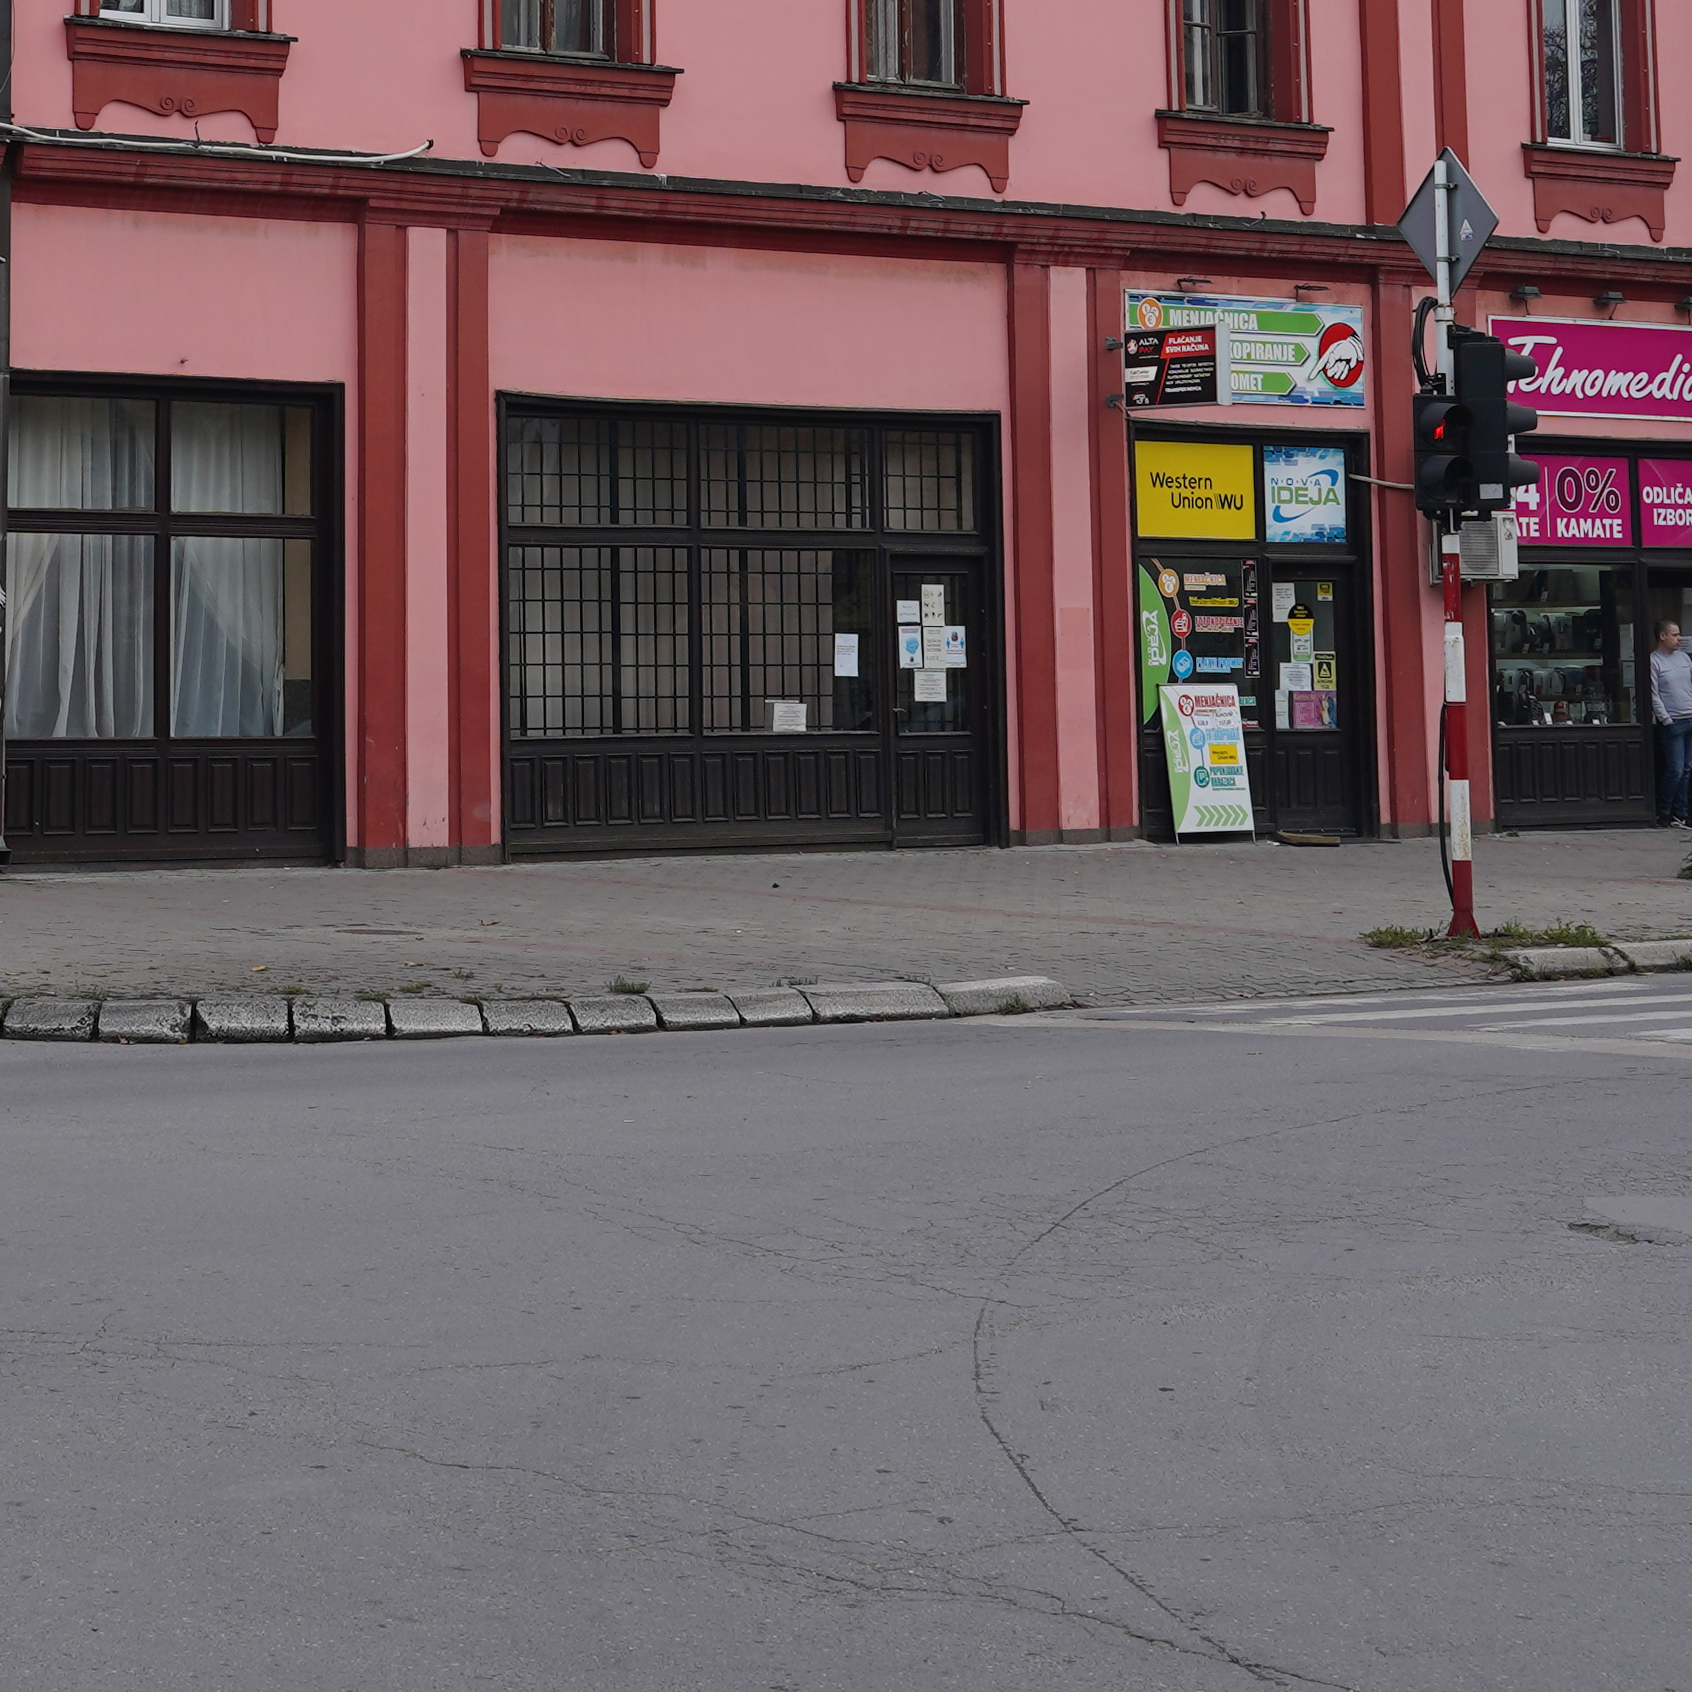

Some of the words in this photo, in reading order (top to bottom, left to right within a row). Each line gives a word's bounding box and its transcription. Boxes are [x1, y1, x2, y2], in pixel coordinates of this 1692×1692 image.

[1139, 337, 1159, 346] ALTA
[1150, 472, 1212, 490] Western
[1556, 466, 1621, 514] 0%
[1171, 491, 1212, 509] Union
[1218, 493, 1243, 510] WU
[1271, 486, 1341, 505] IDEJA
[1557, 518, 1623, 538] KAMATE
